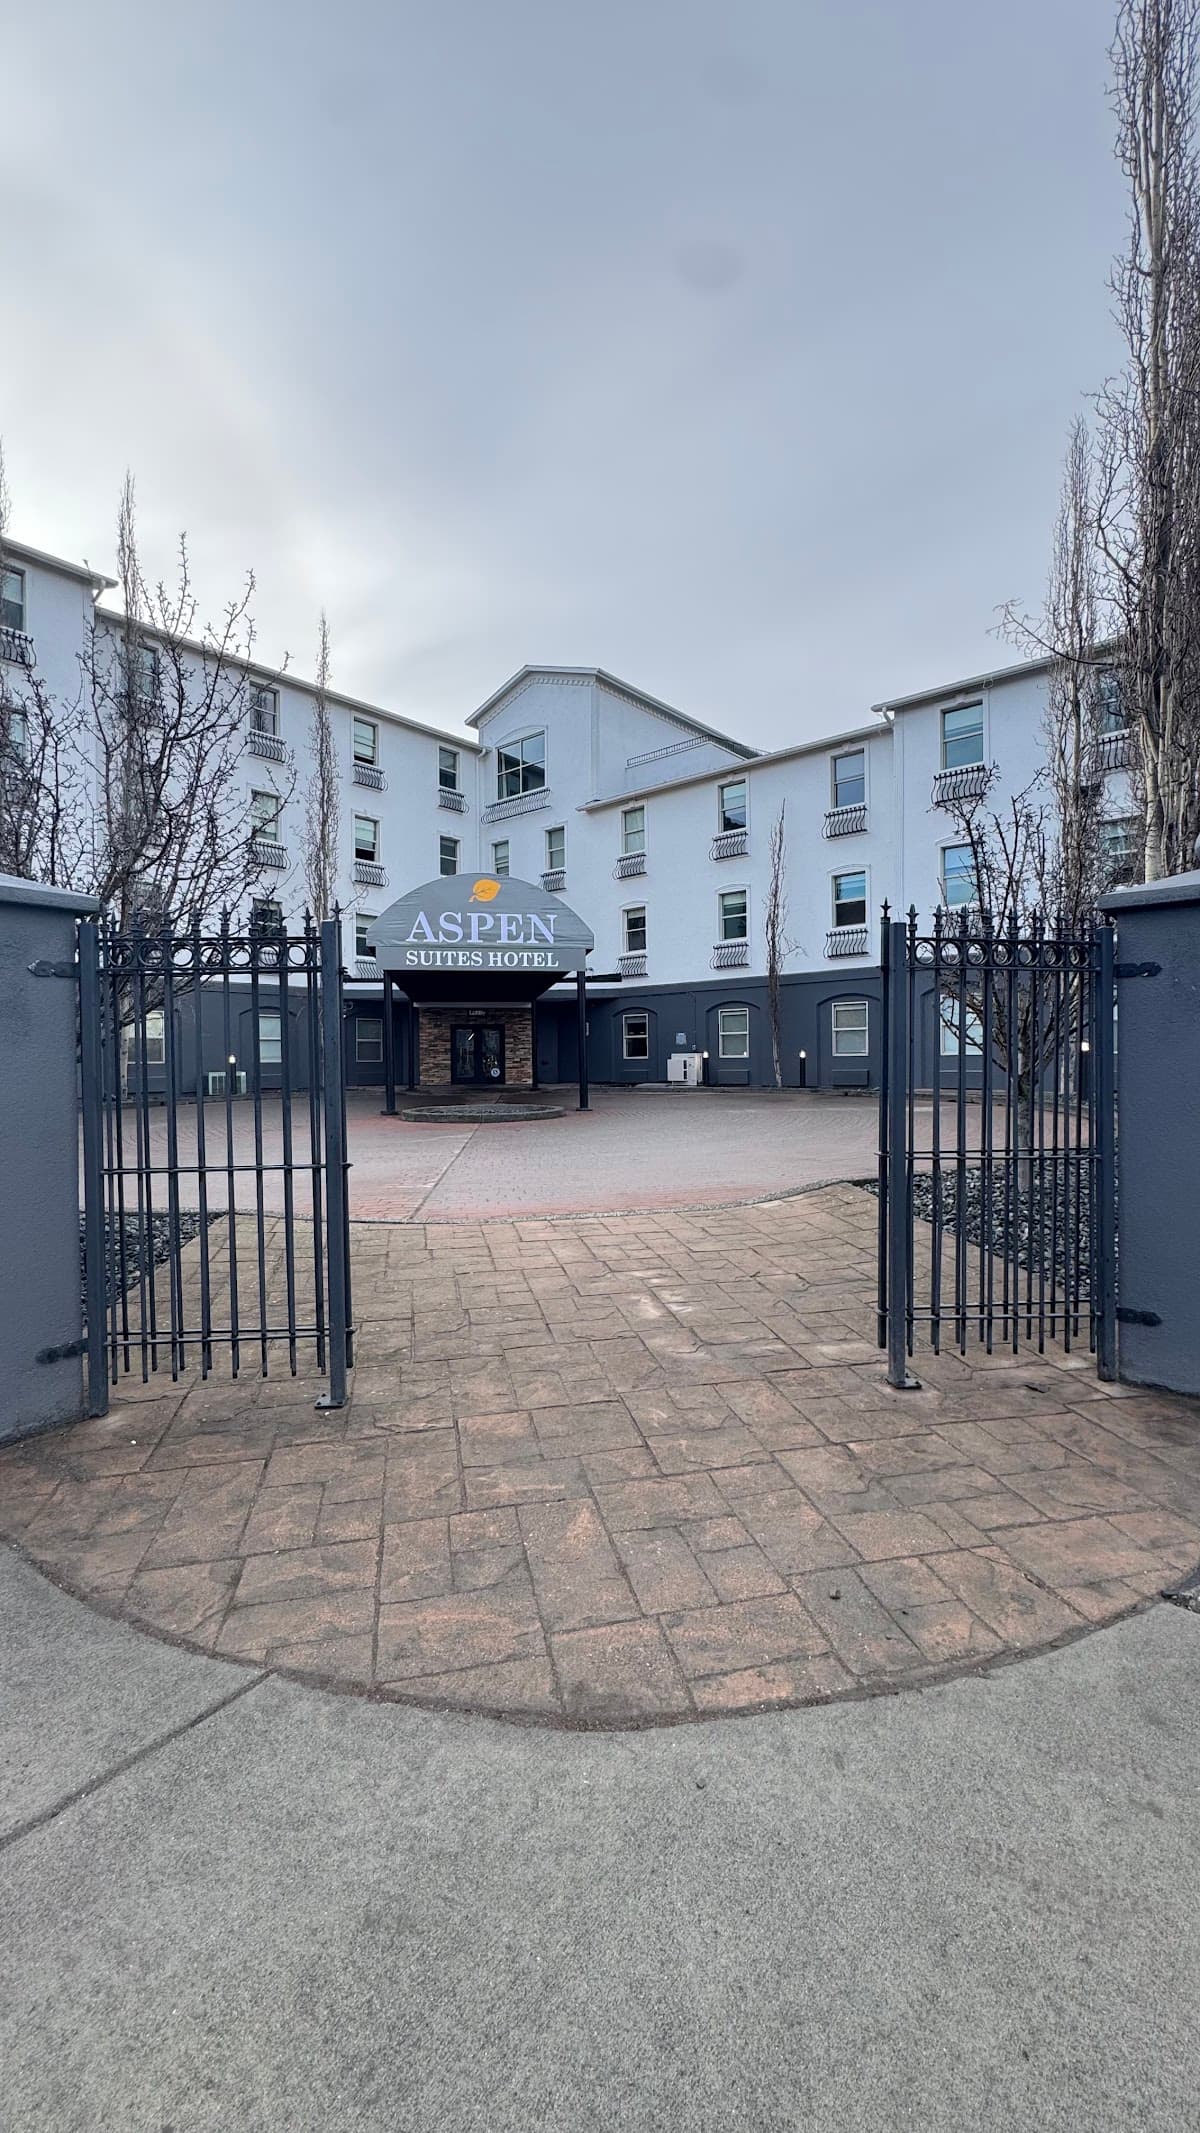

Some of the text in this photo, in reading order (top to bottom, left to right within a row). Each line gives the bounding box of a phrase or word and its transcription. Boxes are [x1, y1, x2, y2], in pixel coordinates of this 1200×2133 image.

[405, 911, 558, 944] ASPEN
[405, 950, 559, 968] SUITES HOTEL
